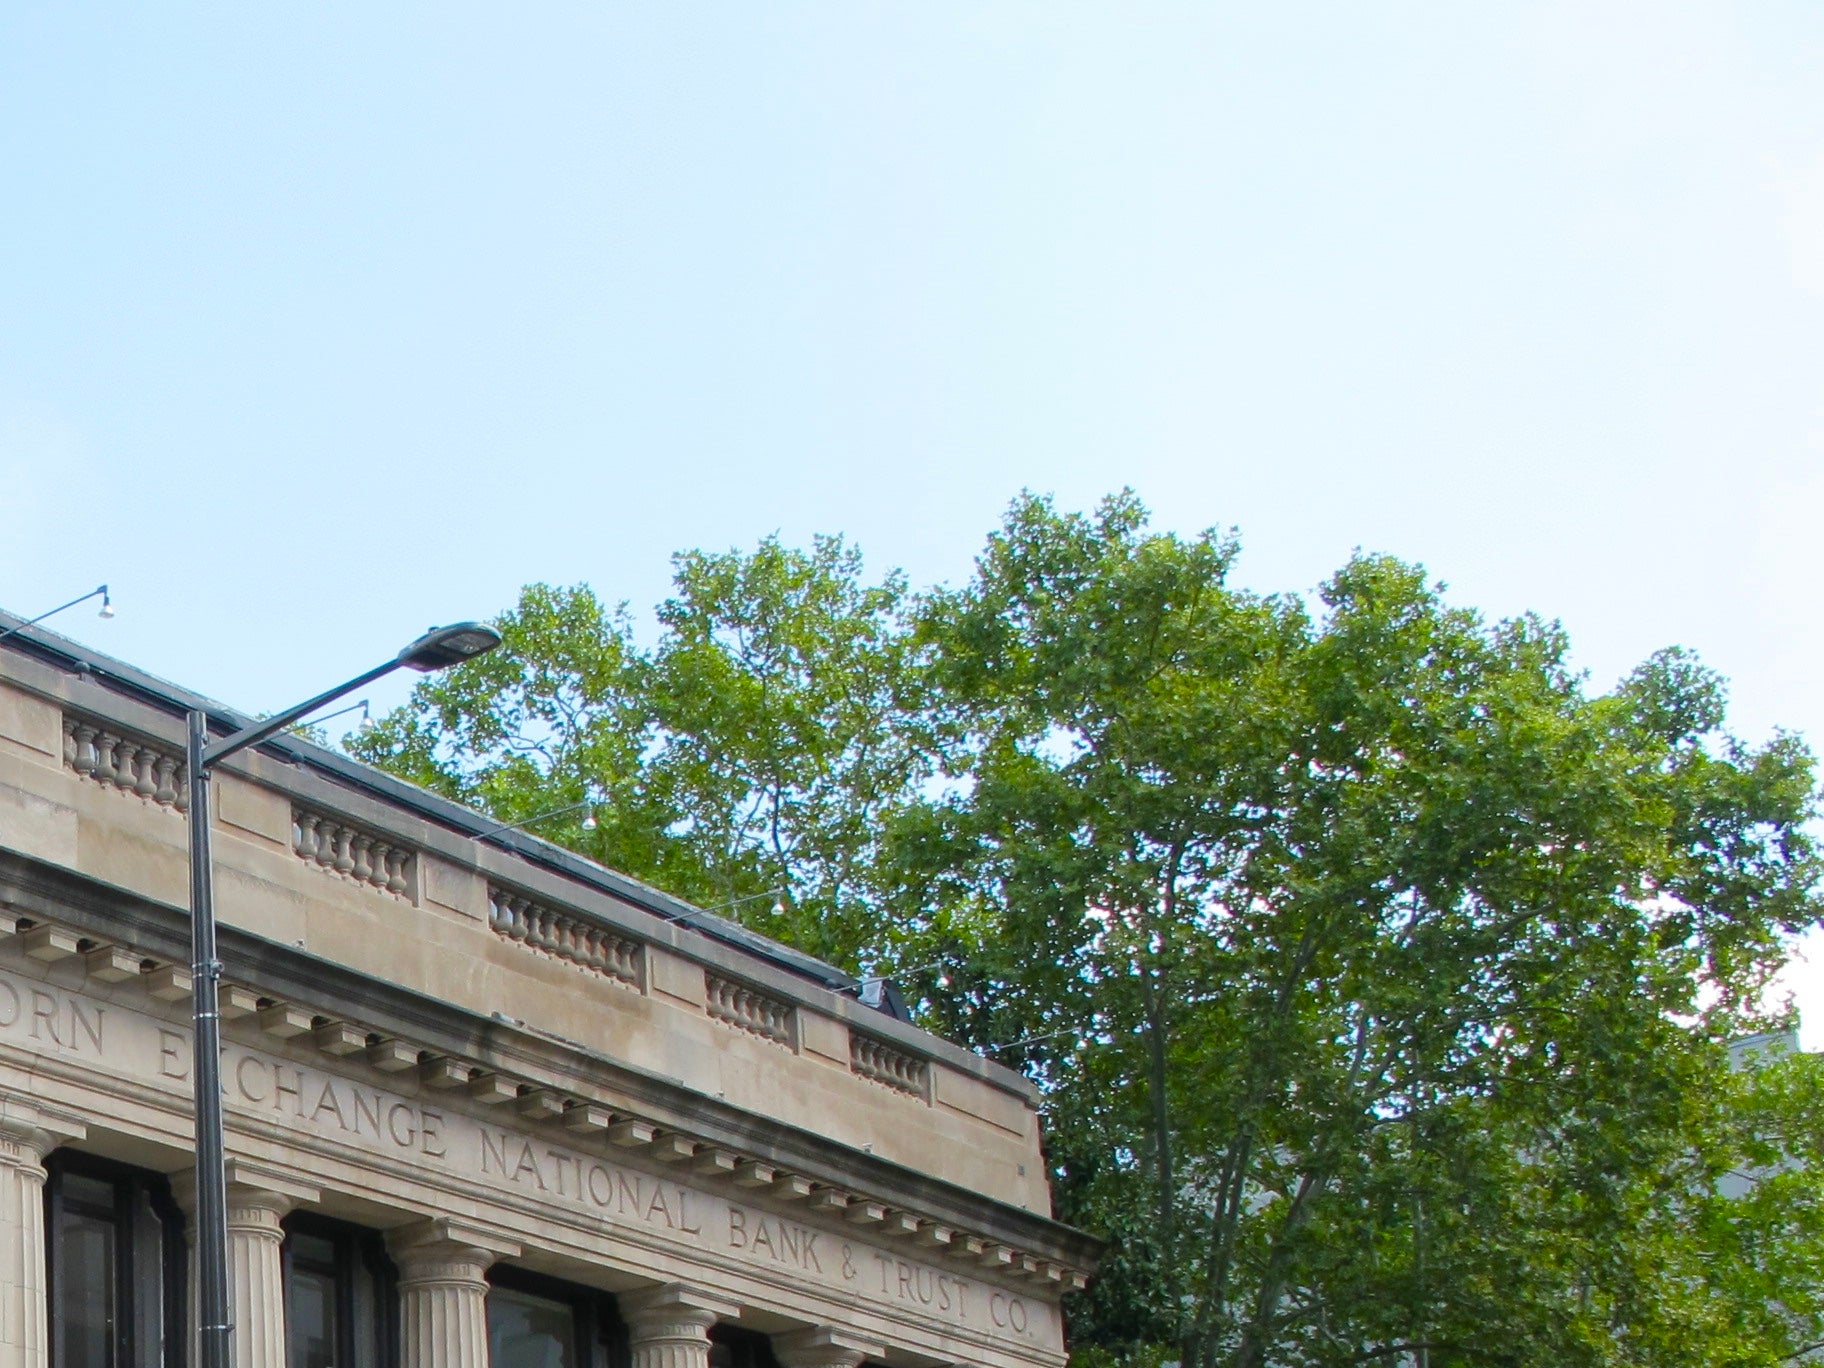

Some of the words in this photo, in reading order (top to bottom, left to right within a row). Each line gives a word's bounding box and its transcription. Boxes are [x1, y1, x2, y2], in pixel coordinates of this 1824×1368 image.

[156, 1026, 448, 1159] ECHANGE
[479, 1128, 702, 1235] NATIONAL
[728, 1207, 824, 1274] BANK
[841, 1246, 858, 1281] &
[874, 1252, 970, 1319] TRUST
[989, 1292, 1035, 1338] CO.
